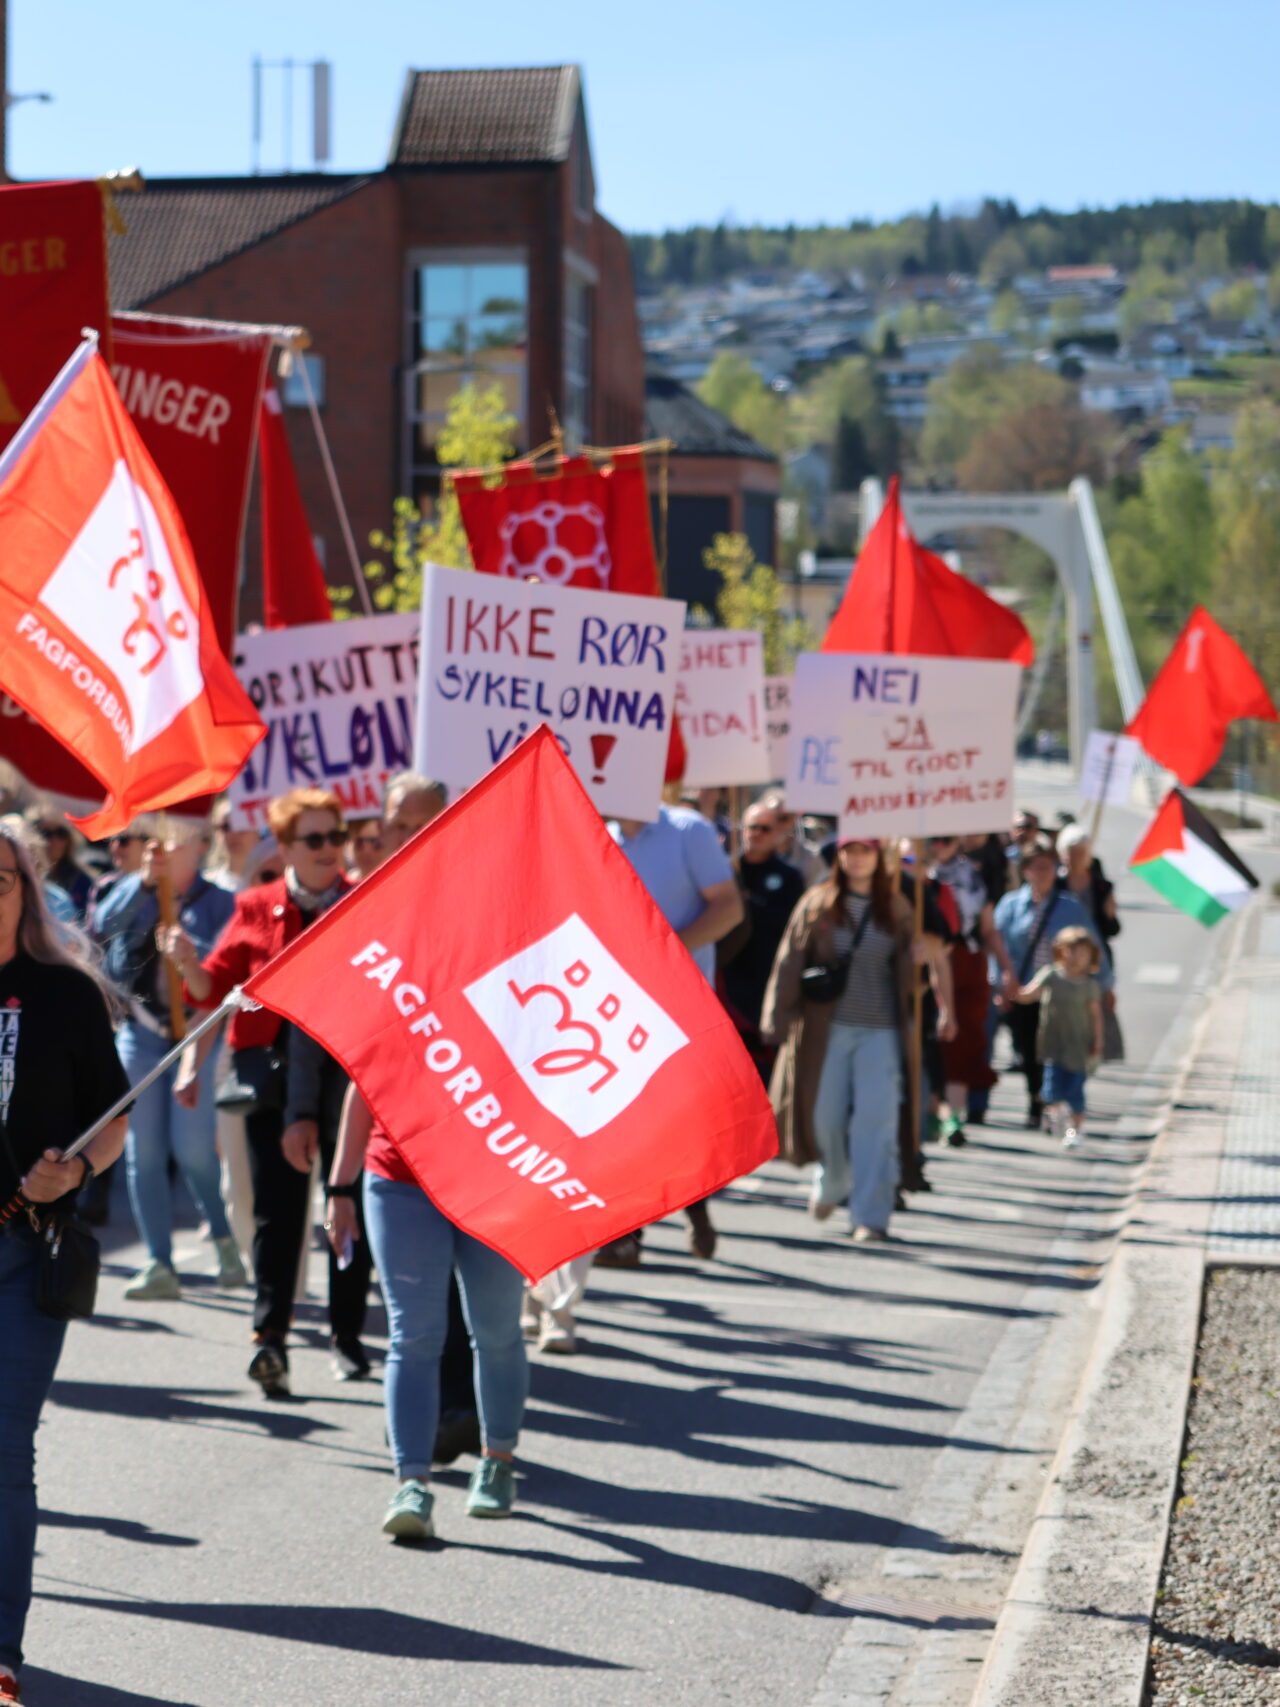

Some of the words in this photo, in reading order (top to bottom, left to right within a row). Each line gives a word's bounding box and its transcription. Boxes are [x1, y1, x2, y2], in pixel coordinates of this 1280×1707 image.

[444, 596, 556, 661] IKKE
[577, 615, 668, 674] RØR
[435, 664, 666, 732] SYKELØNNA
[851, 664, 920, 706] NEI
[884, 716, 933, 750] JA
[850, 759, 893, 780] TIL
[350, 940, 606, 1212] FAGFORBUNDET
